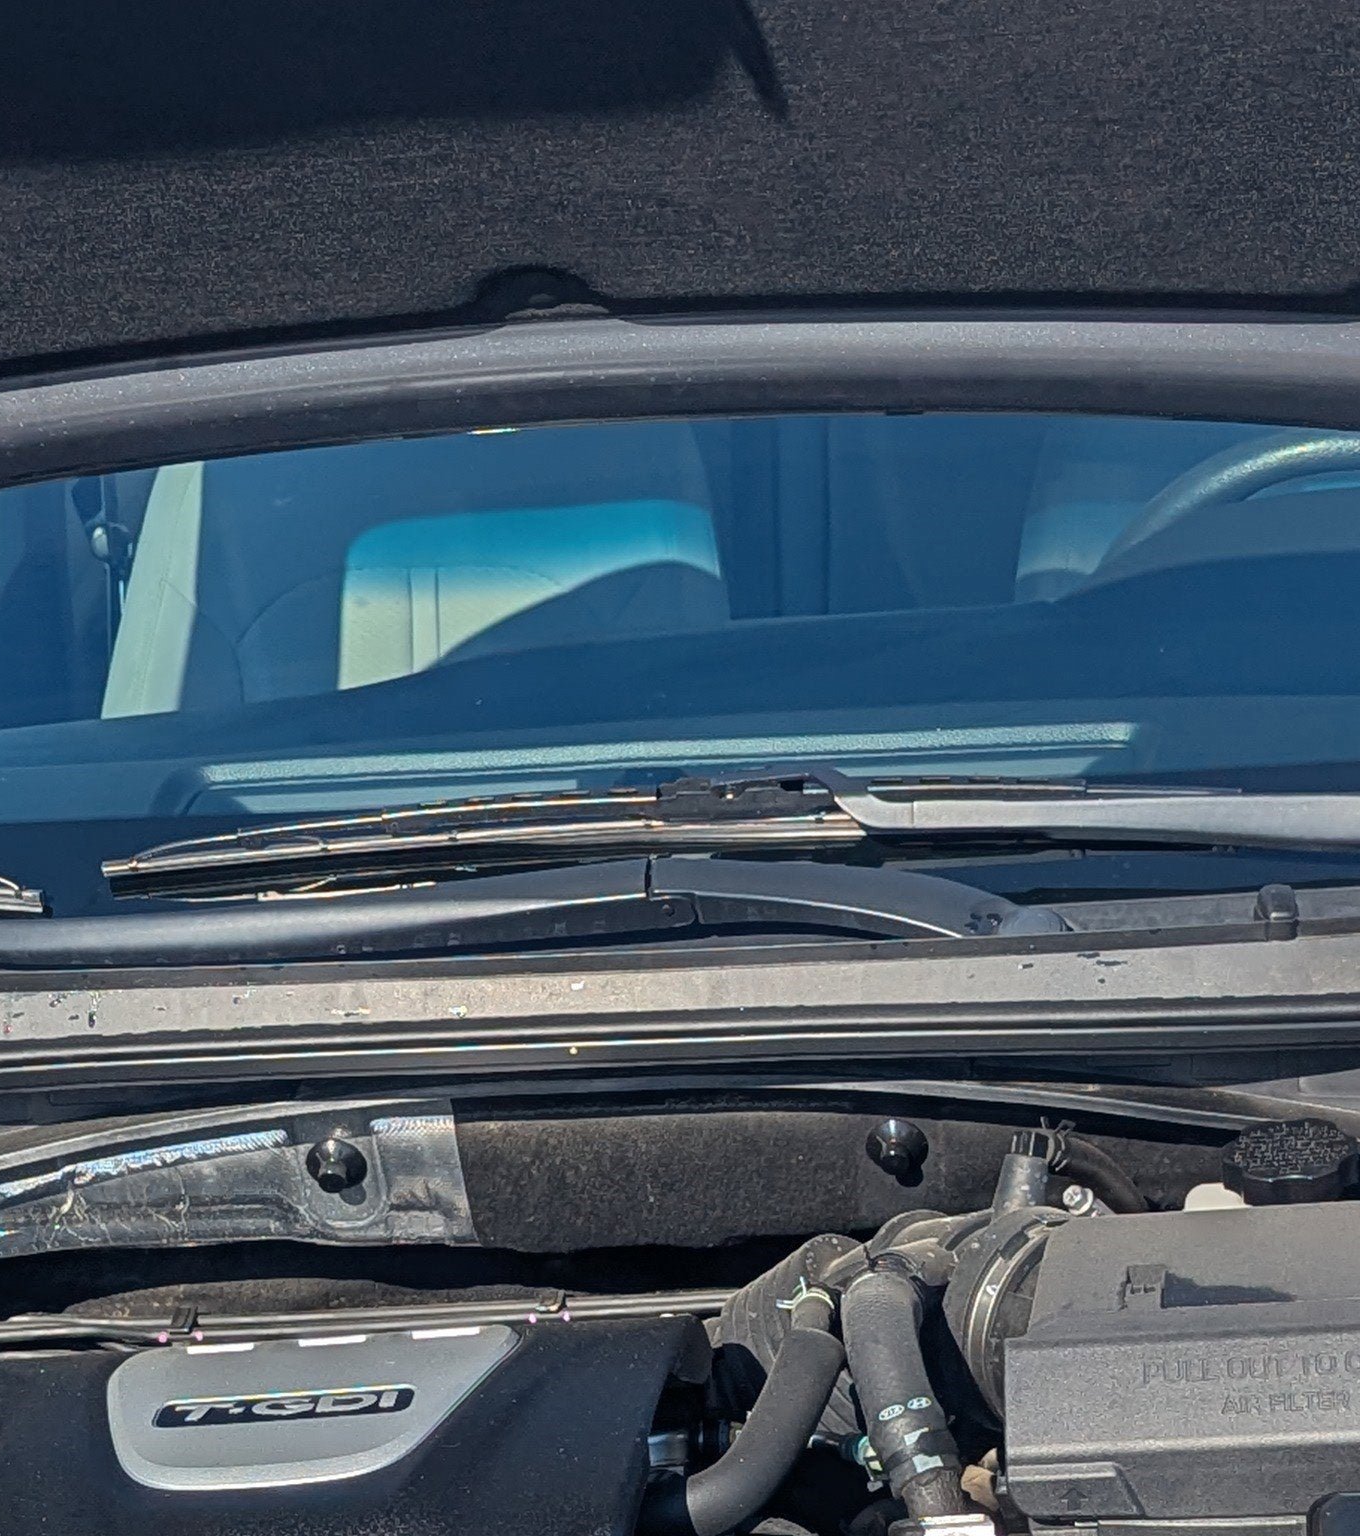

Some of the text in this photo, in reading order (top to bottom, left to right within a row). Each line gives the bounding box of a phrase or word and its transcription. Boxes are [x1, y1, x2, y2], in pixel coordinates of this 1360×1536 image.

[1142, 1358, 1220, 1384] PULL
[1226, 1355, 1293, 1380] OUT
[1300, 1352, 1339, 1377] TO
[1221, 1390, 1352, 1415] AIR FILTER
